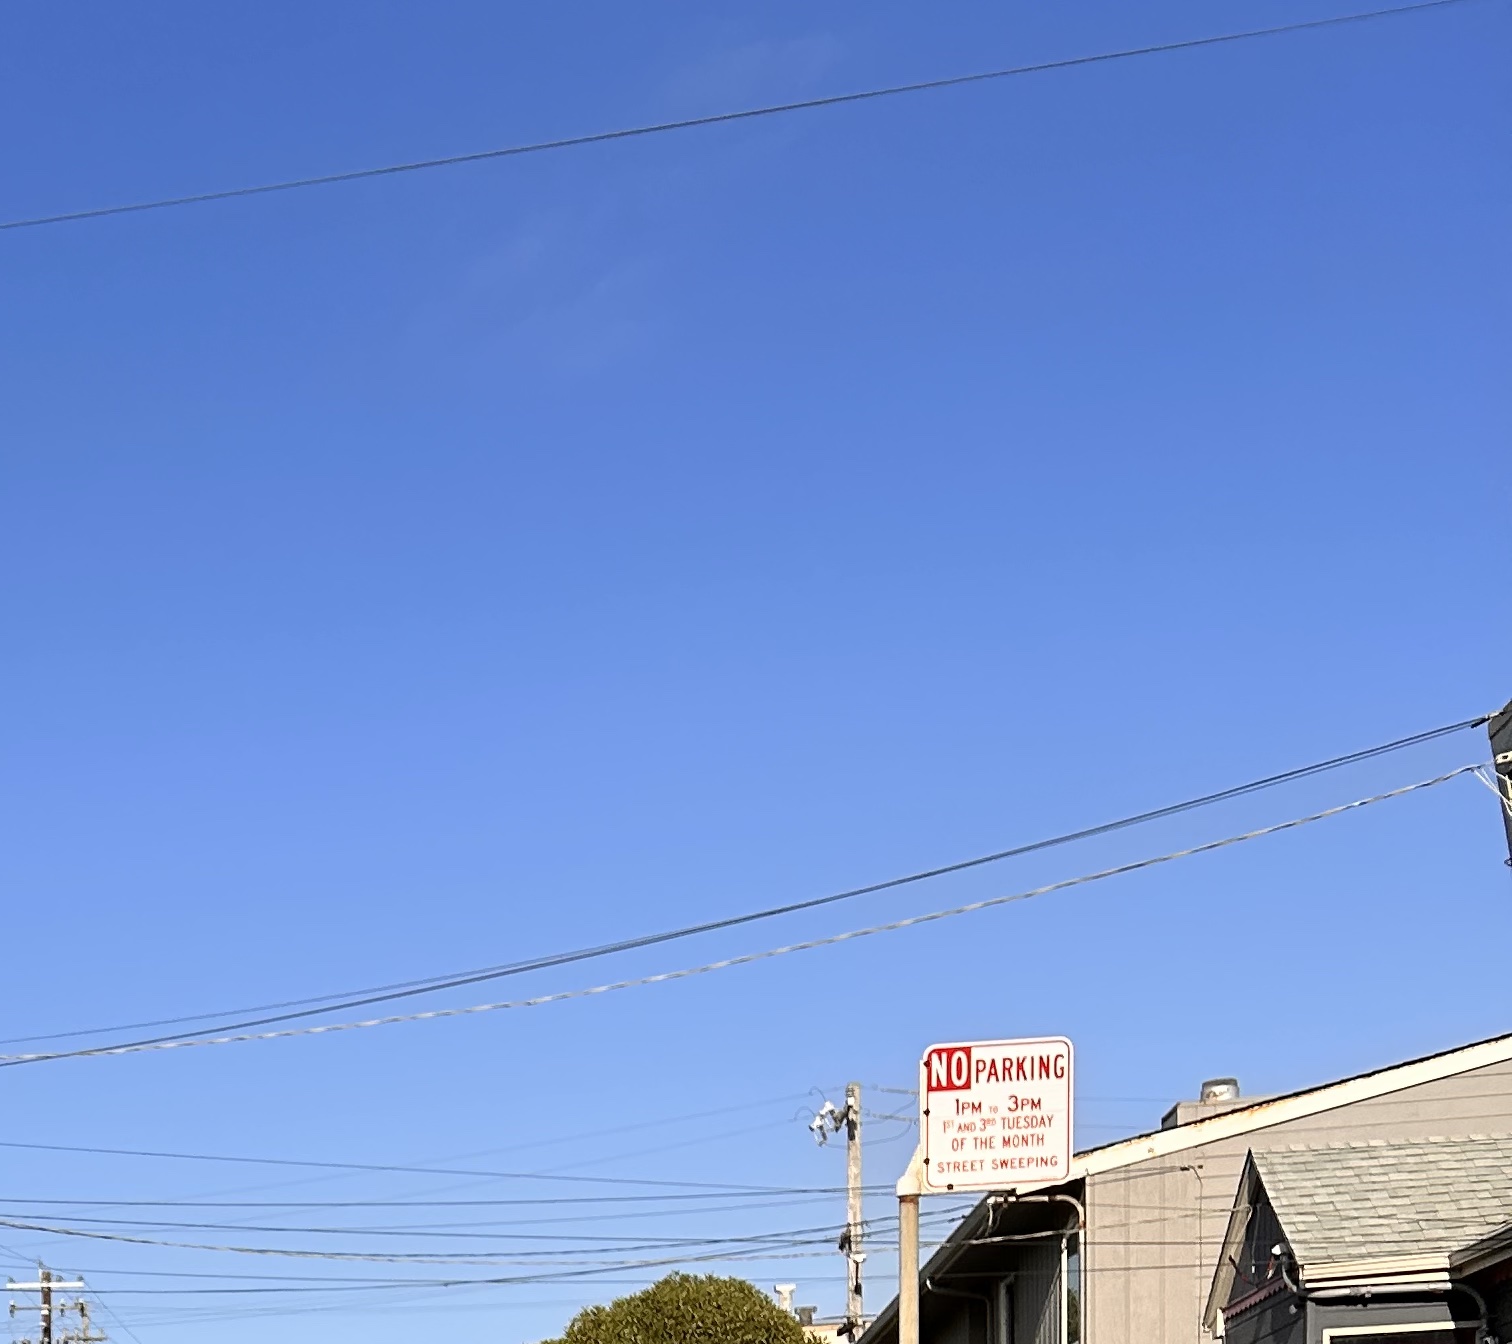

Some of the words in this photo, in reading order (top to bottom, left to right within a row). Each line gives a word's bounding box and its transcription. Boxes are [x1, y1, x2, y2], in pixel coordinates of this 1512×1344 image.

[931, 1050, 968, 1088] NO
[975, 1053, 1065, 1084] PARKING
[955, 1097, 982, 1116] 1PM
[989, 1105, 999, 1114] TO
[1007, 1094, 1042, 1112] 3PM
[957, 1121, 977, 1133] AND
[1000, 1113, 1054, 1131] TUESDAY
[951, 1137, 967, 1152] OF
[973, 1135, 996, 1150] THE
[1002, 1133, 1045, 1149] MONTH
[937, 1159, 985, 1174] STREET
[991, 1155, 1058, 1170] SWEEPING
